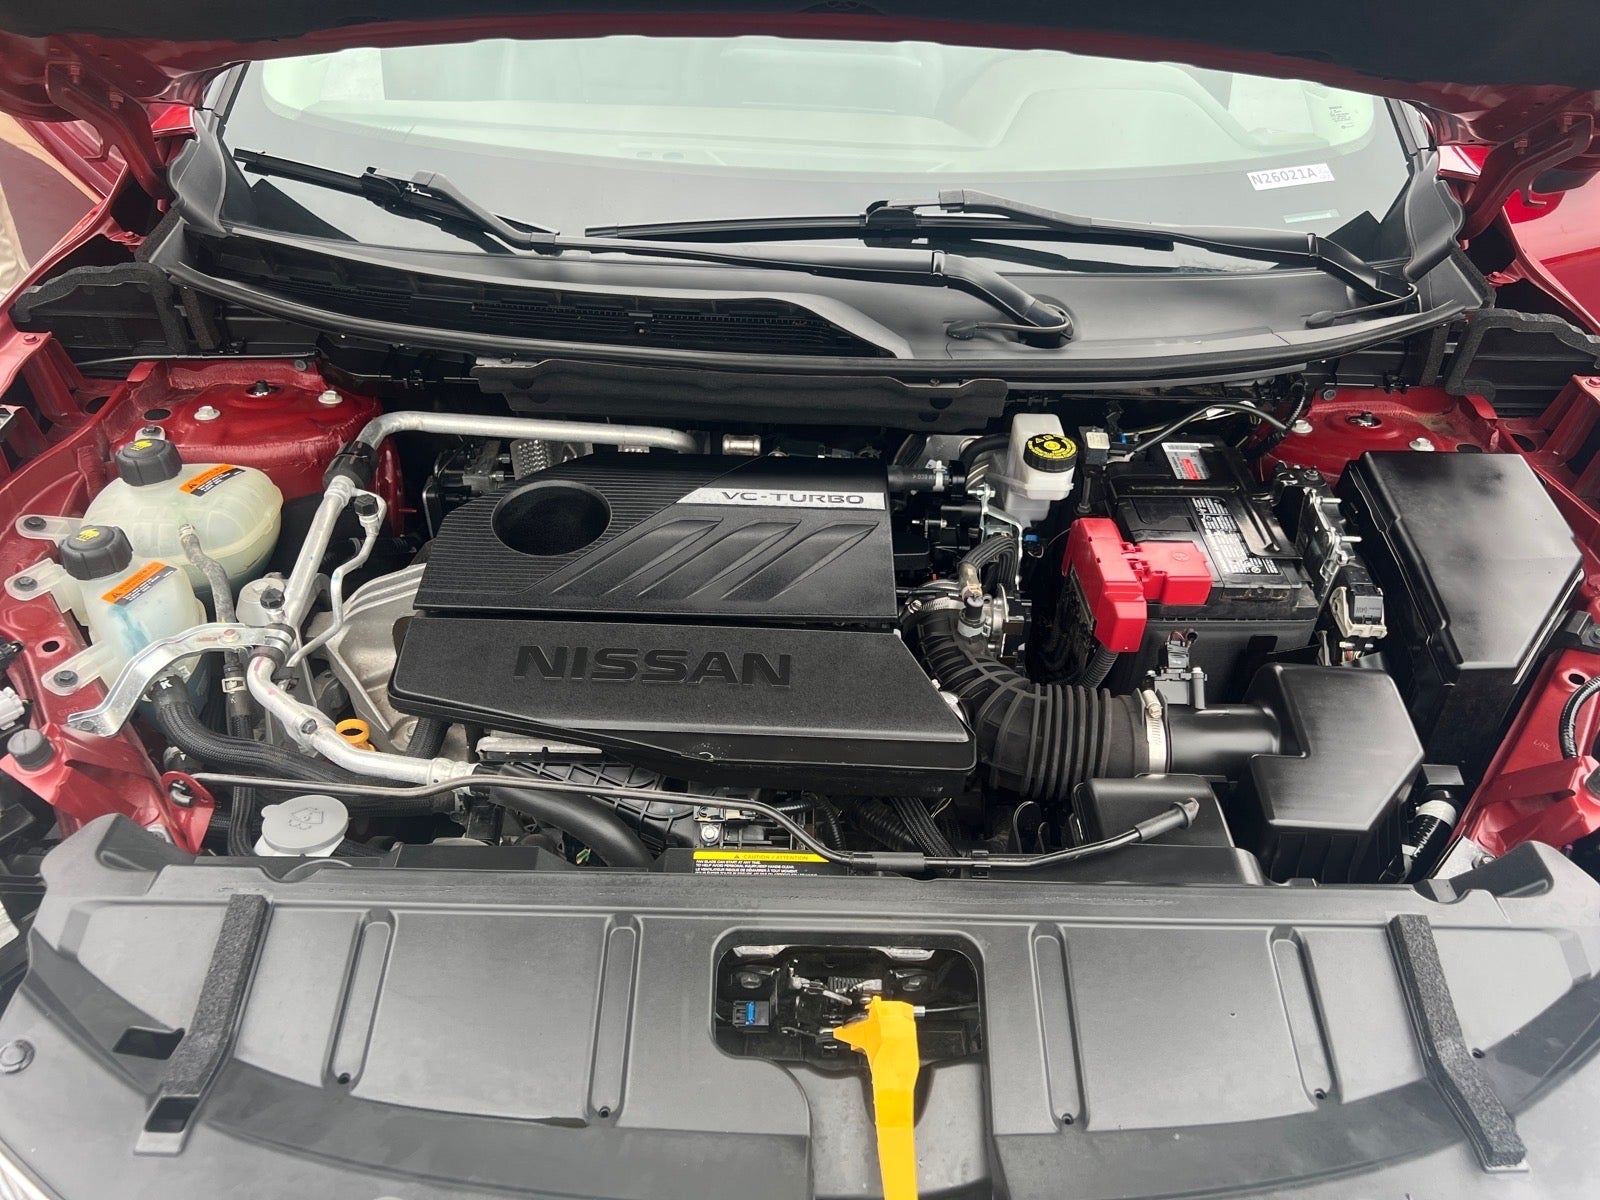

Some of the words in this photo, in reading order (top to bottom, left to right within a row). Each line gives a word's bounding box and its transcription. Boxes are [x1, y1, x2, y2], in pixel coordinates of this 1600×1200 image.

[1250, 167, 1317, 185] N26021A
[721, 491, 864, 505] VC-TURBO
[512, 645, 791, 688] NISSAN
